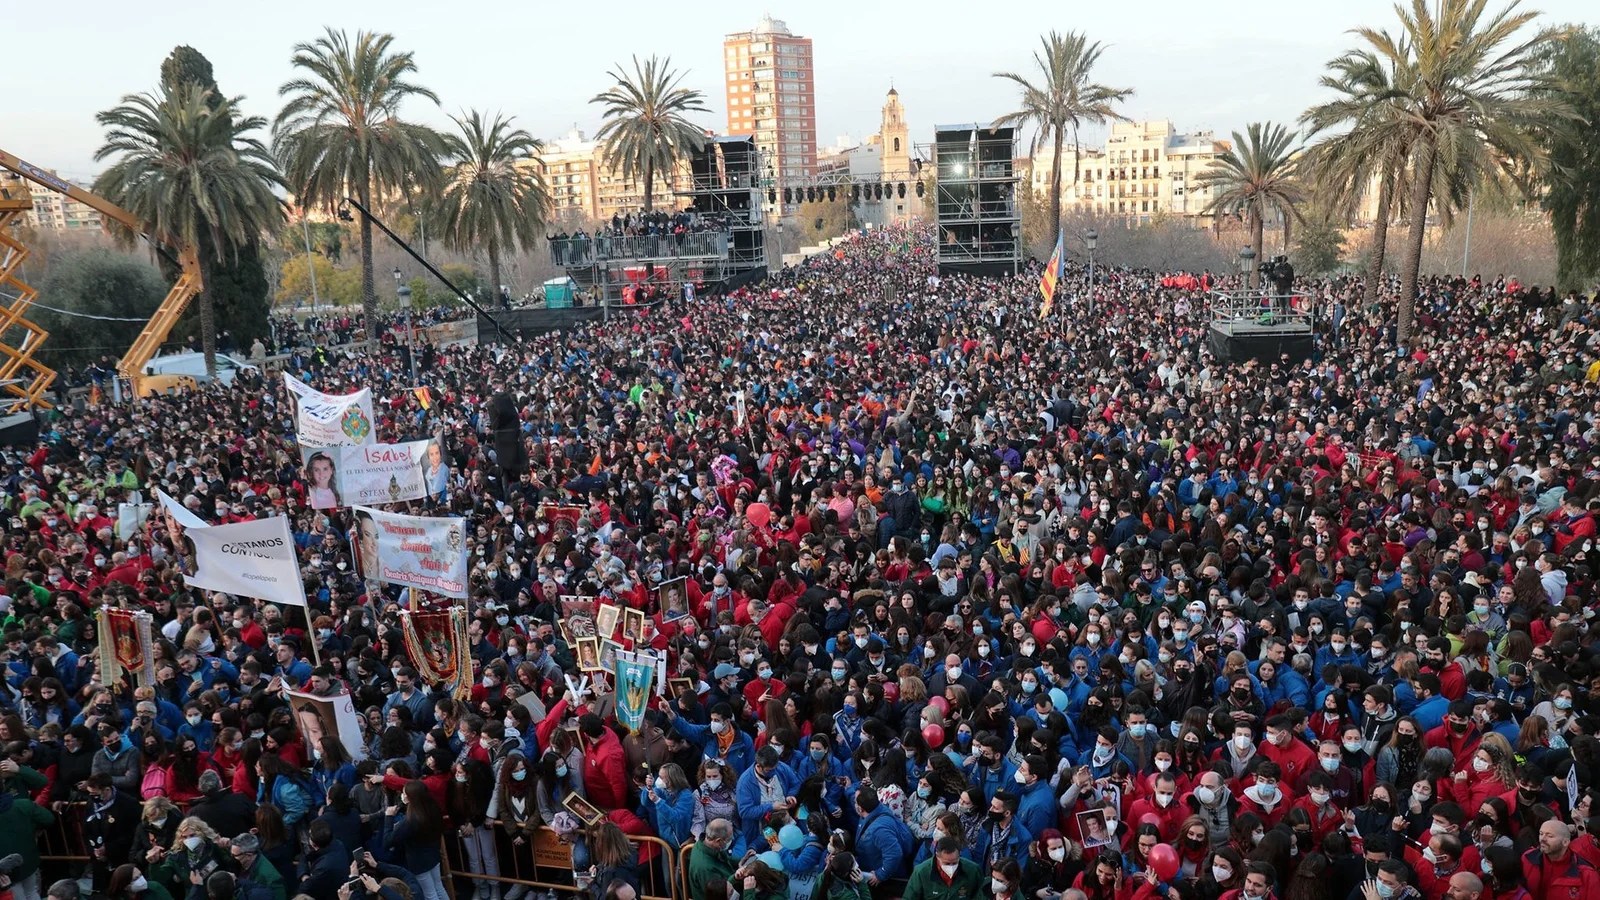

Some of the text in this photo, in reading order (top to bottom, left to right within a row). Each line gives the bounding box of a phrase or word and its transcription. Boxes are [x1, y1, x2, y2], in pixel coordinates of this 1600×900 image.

[364, 445, 412, 464] Isabel
[359, 484, 419, 498] ESTEM AMB
